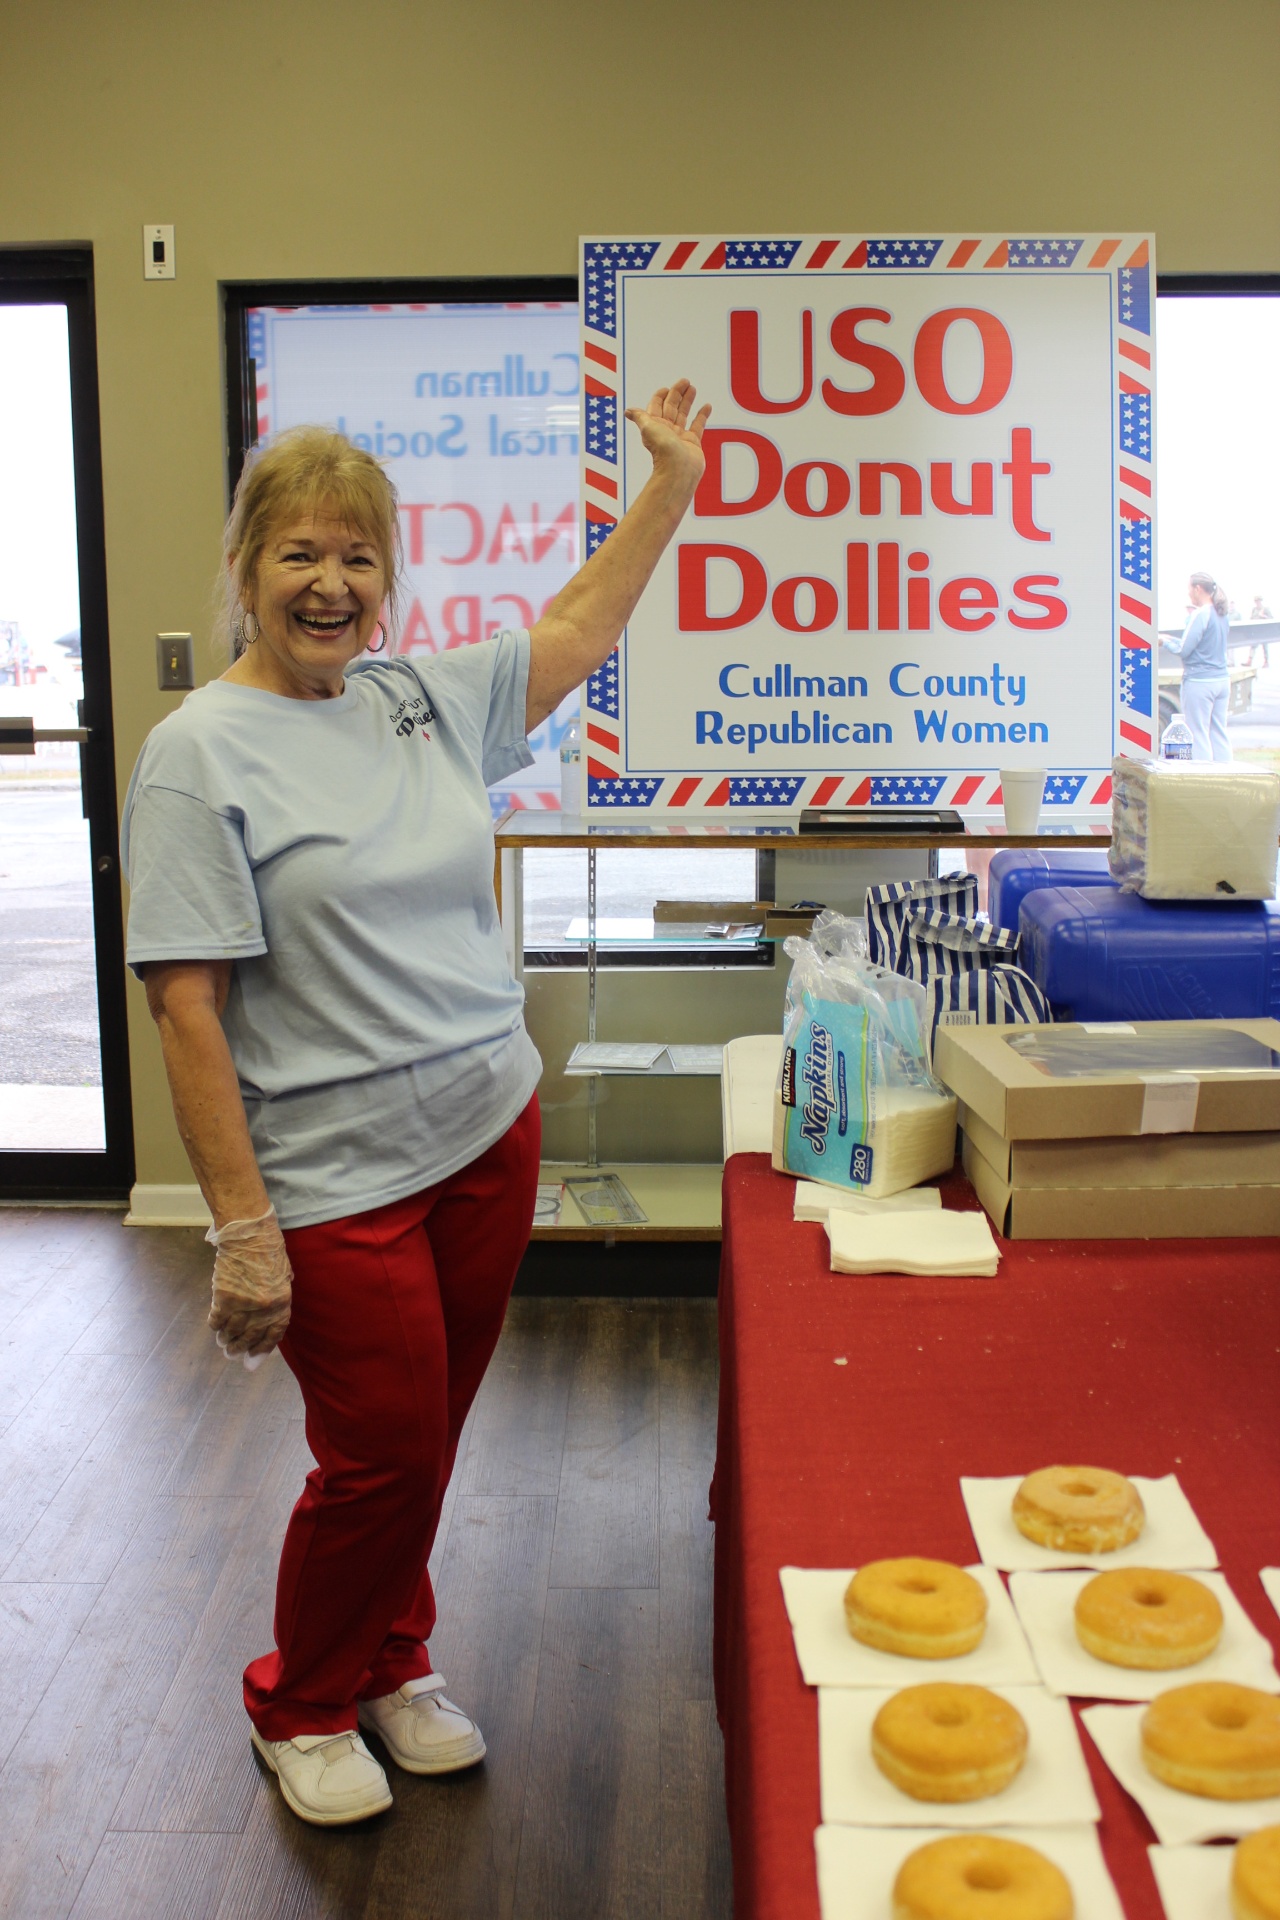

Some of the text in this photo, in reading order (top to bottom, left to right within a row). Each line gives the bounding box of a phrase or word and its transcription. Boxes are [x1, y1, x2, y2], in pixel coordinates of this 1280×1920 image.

[730, 307, 1013, 416] USO
[693, 427, 1051, 542] Donut
[677, 542, 1068, 632] Dollies
[719, 662, 1027, 707] Cullman County
[695, 709, 1050, 754] Republican Women
[783, 1048, 793, 1104] KIRKLAND
[801, 1021, 836, 1155] Napkins
[853, 1149, 867, 1180] 280
